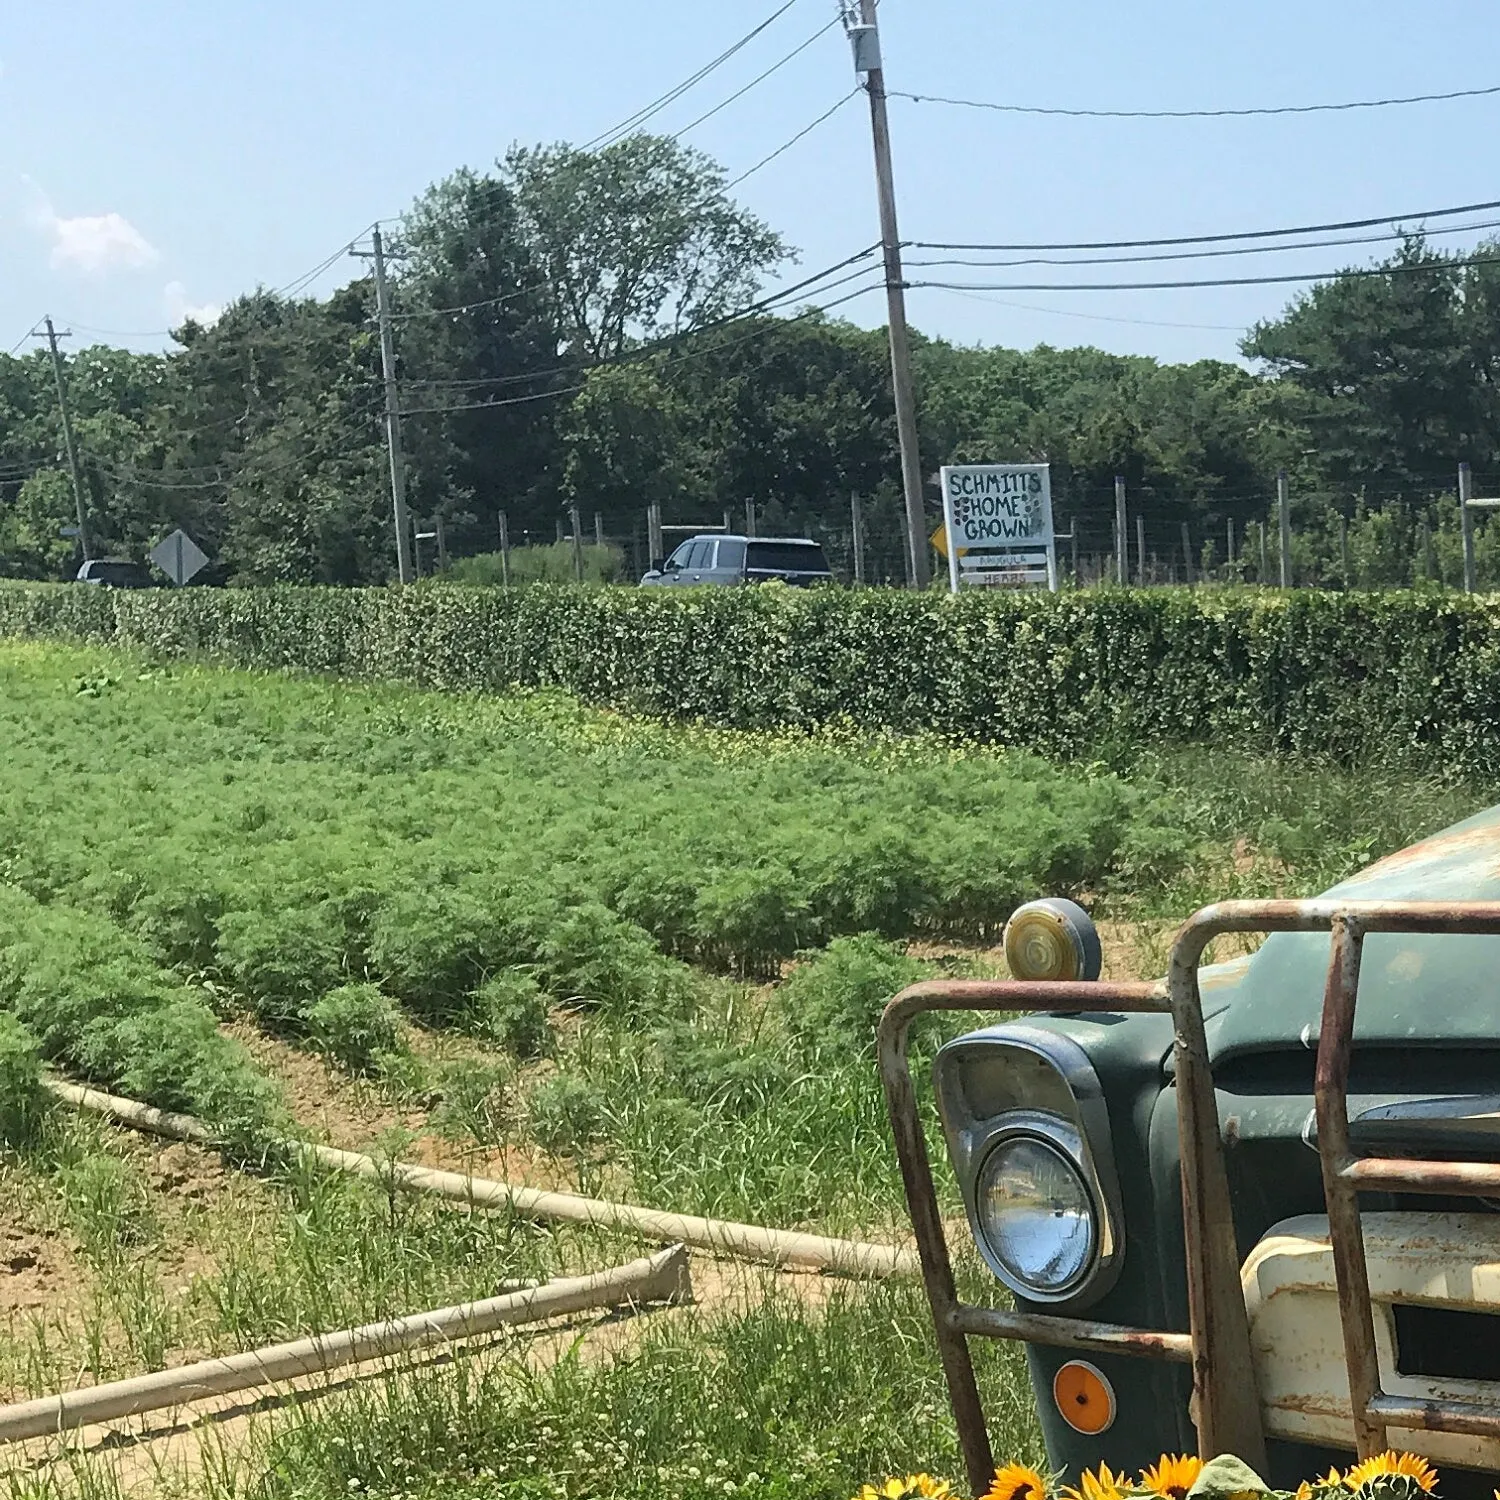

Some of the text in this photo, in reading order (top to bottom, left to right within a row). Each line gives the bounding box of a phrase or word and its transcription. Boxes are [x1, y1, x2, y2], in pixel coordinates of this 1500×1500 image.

[950, 472, 1042, 496] SCHMITTS
[970, 495, 1021, 517] HOME
[964, 519, 1030, 540] GROWN
